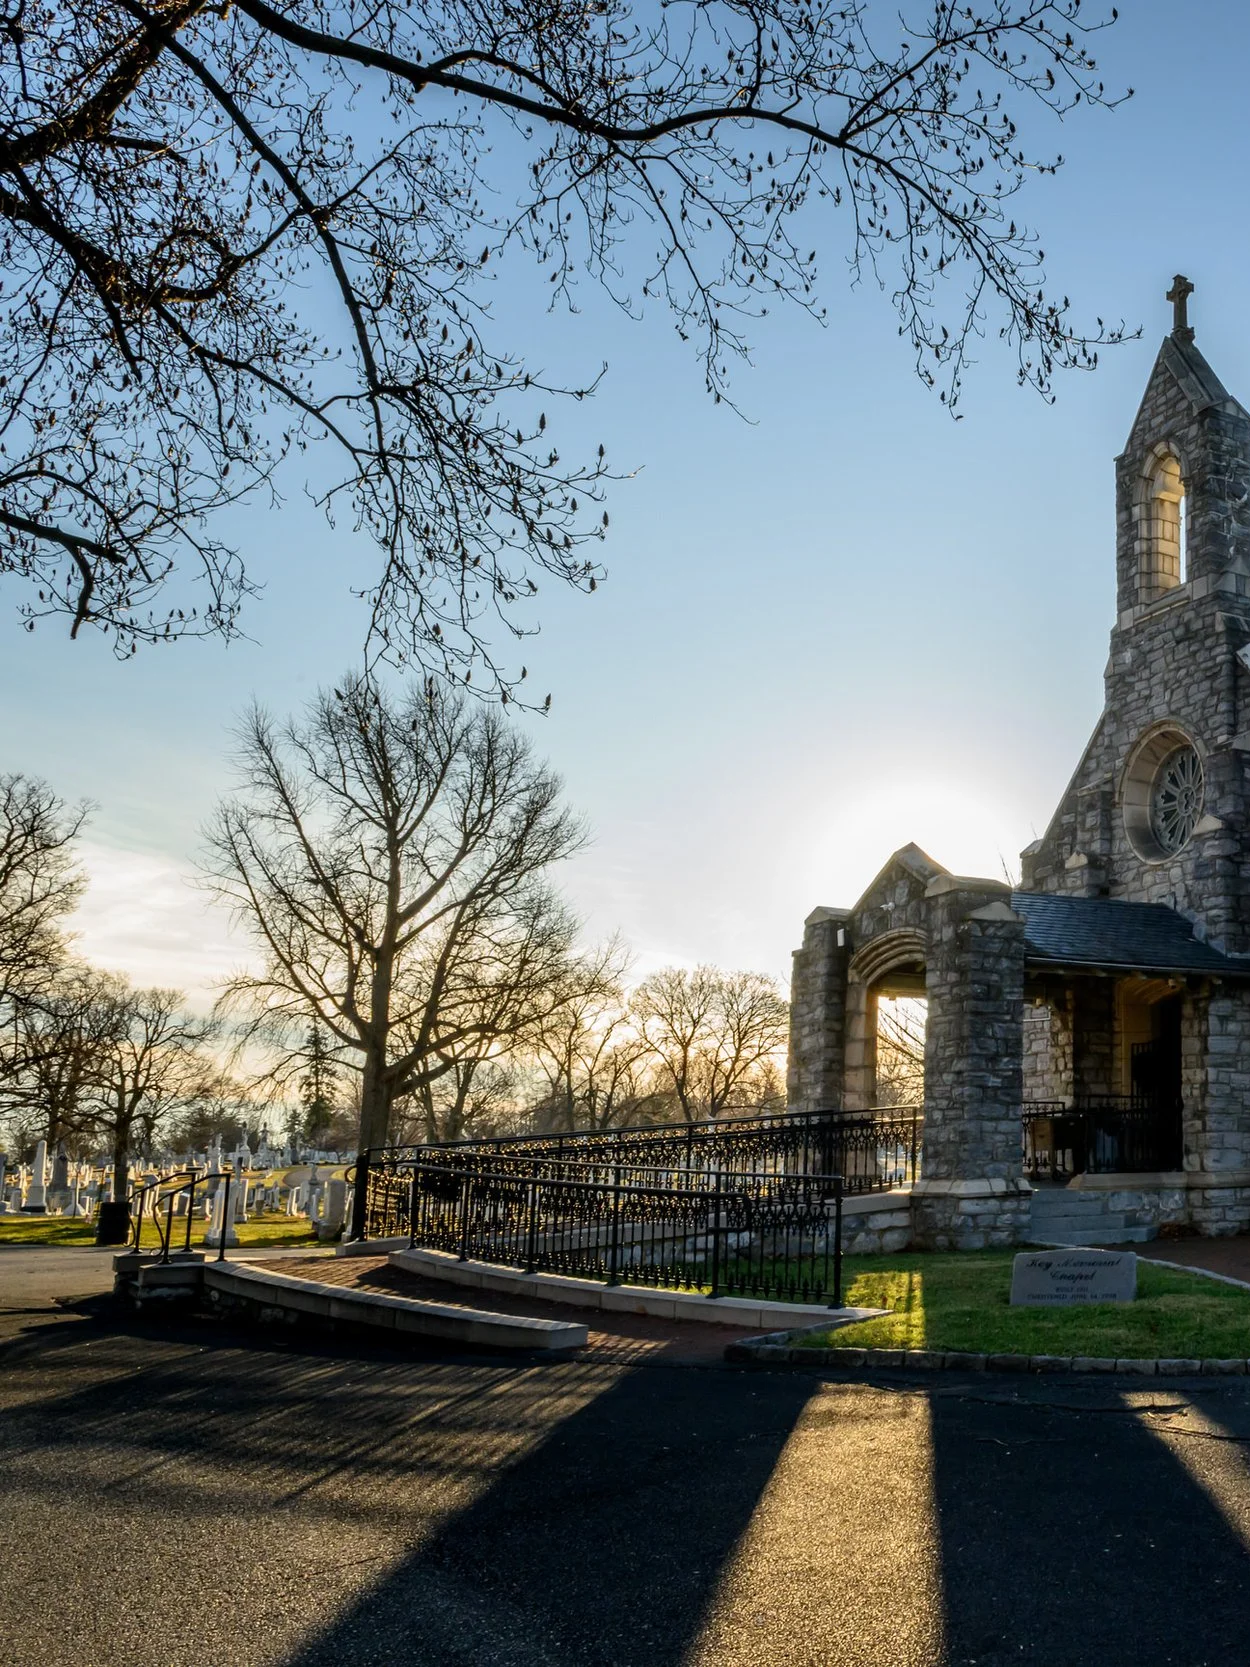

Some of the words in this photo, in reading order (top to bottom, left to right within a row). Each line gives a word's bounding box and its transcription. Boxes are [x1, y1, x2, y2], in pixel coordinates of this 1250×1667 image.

[1026, 1259, 1053, 1271] Key
[1057, 1257, 1121, 1268] Memorial
[1050, 1270, 1097, 1283] Chapel
